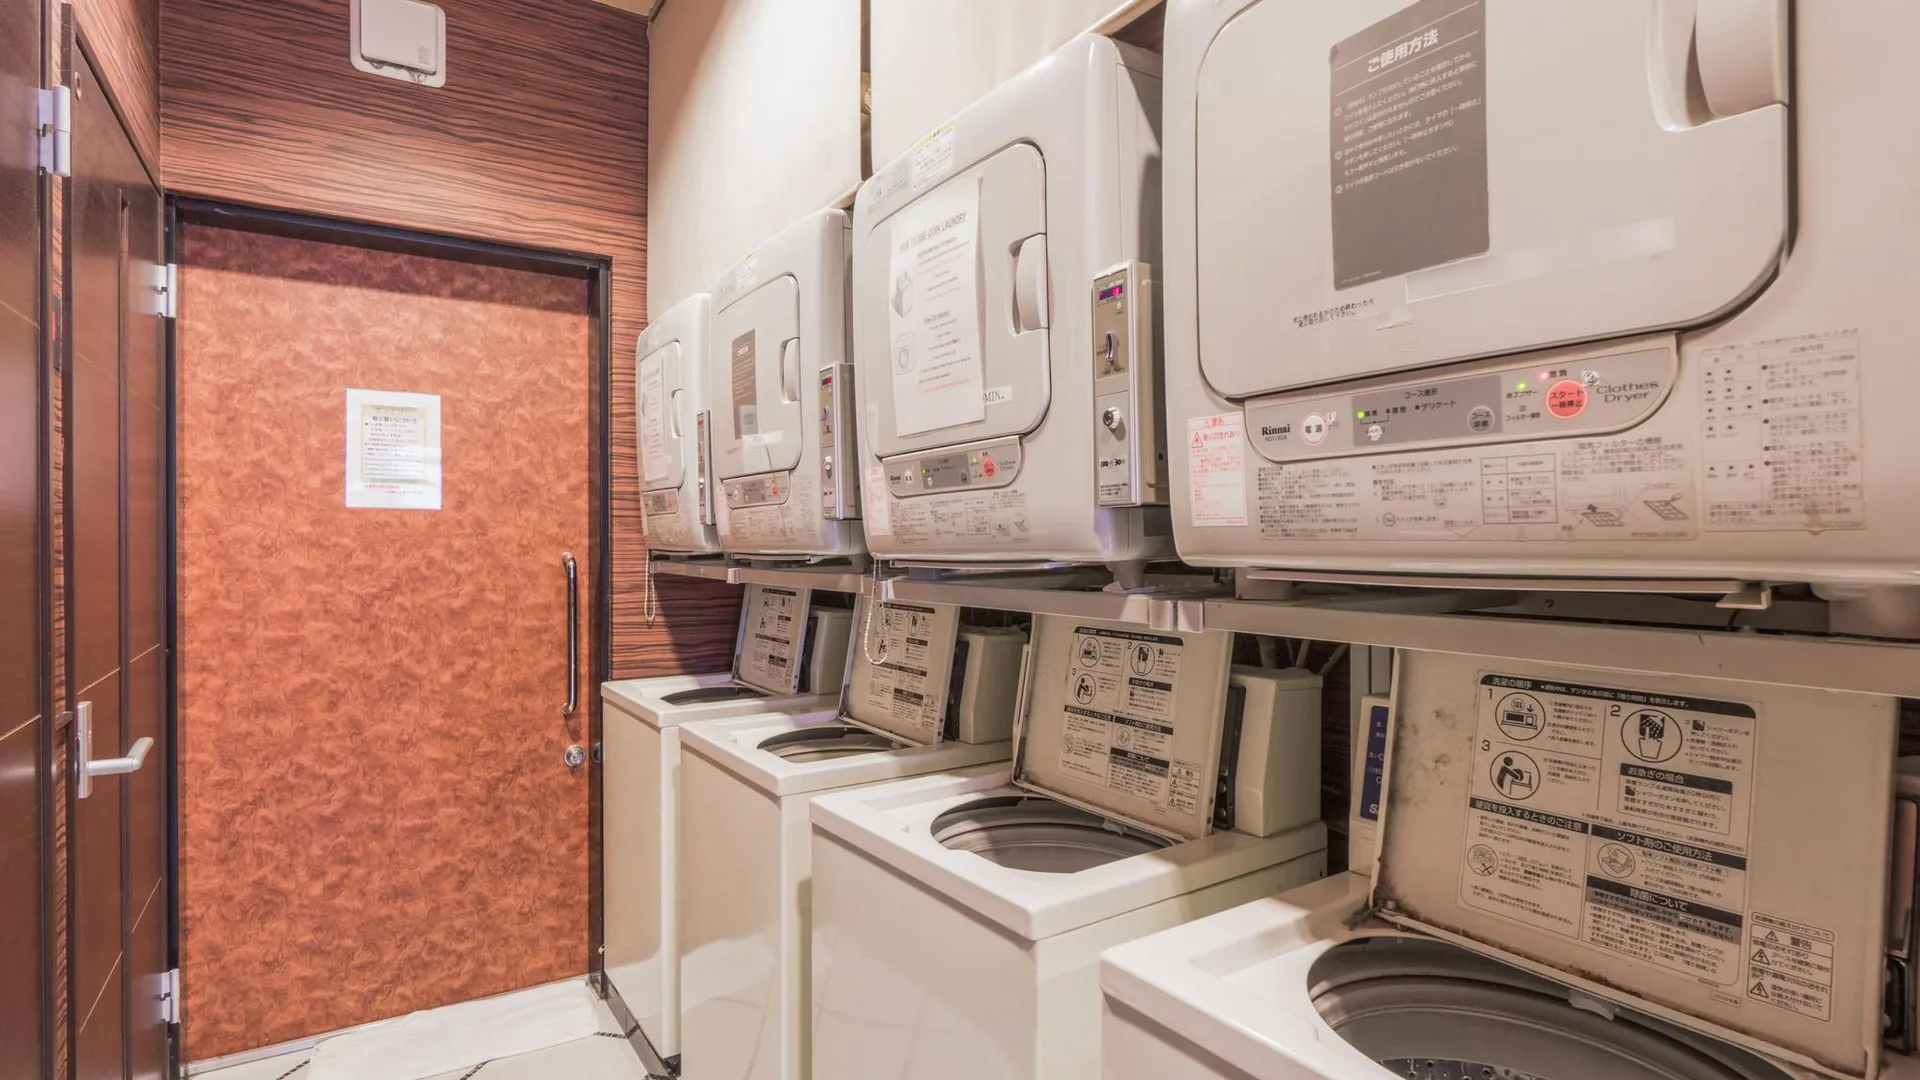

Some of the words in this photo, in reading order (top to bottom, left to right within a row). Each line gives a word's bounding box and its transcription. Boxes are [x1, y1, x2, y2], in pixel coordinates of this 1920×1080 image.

[1367, 28, 1440, 73] ご使用方法
[1404, 387, 1438, 400] コース選択
[1550, 389, 1585, 400] スタート
[1595, 380, 1660, 396] Clothes
[1603, 390, 1650, 404] Dryer
[1421, 400, 1457, 411] デリケート
[1551, 400, 1584, 409] 一時停止
[1470, 411, 1491, 420] コース
[1261, 424, 1291, 436] Rinnai
[1304, 424, 1322, 434] 電源
[1491, 676, 1533, 690] 洗濯の順序
[1487, 688, 1493, 700] 1
[1610, 704, 1622, 717] 2
[1481, 739, 1491, 751] 3
[1627, 766, 1685, 784] お急ぎの場合
[1615, 831, 1714, 862] ソフト剤のご使用方法
[1629, 888, 1689, 911] 除菌について
[1790, 936, 1812, 950] 警告
